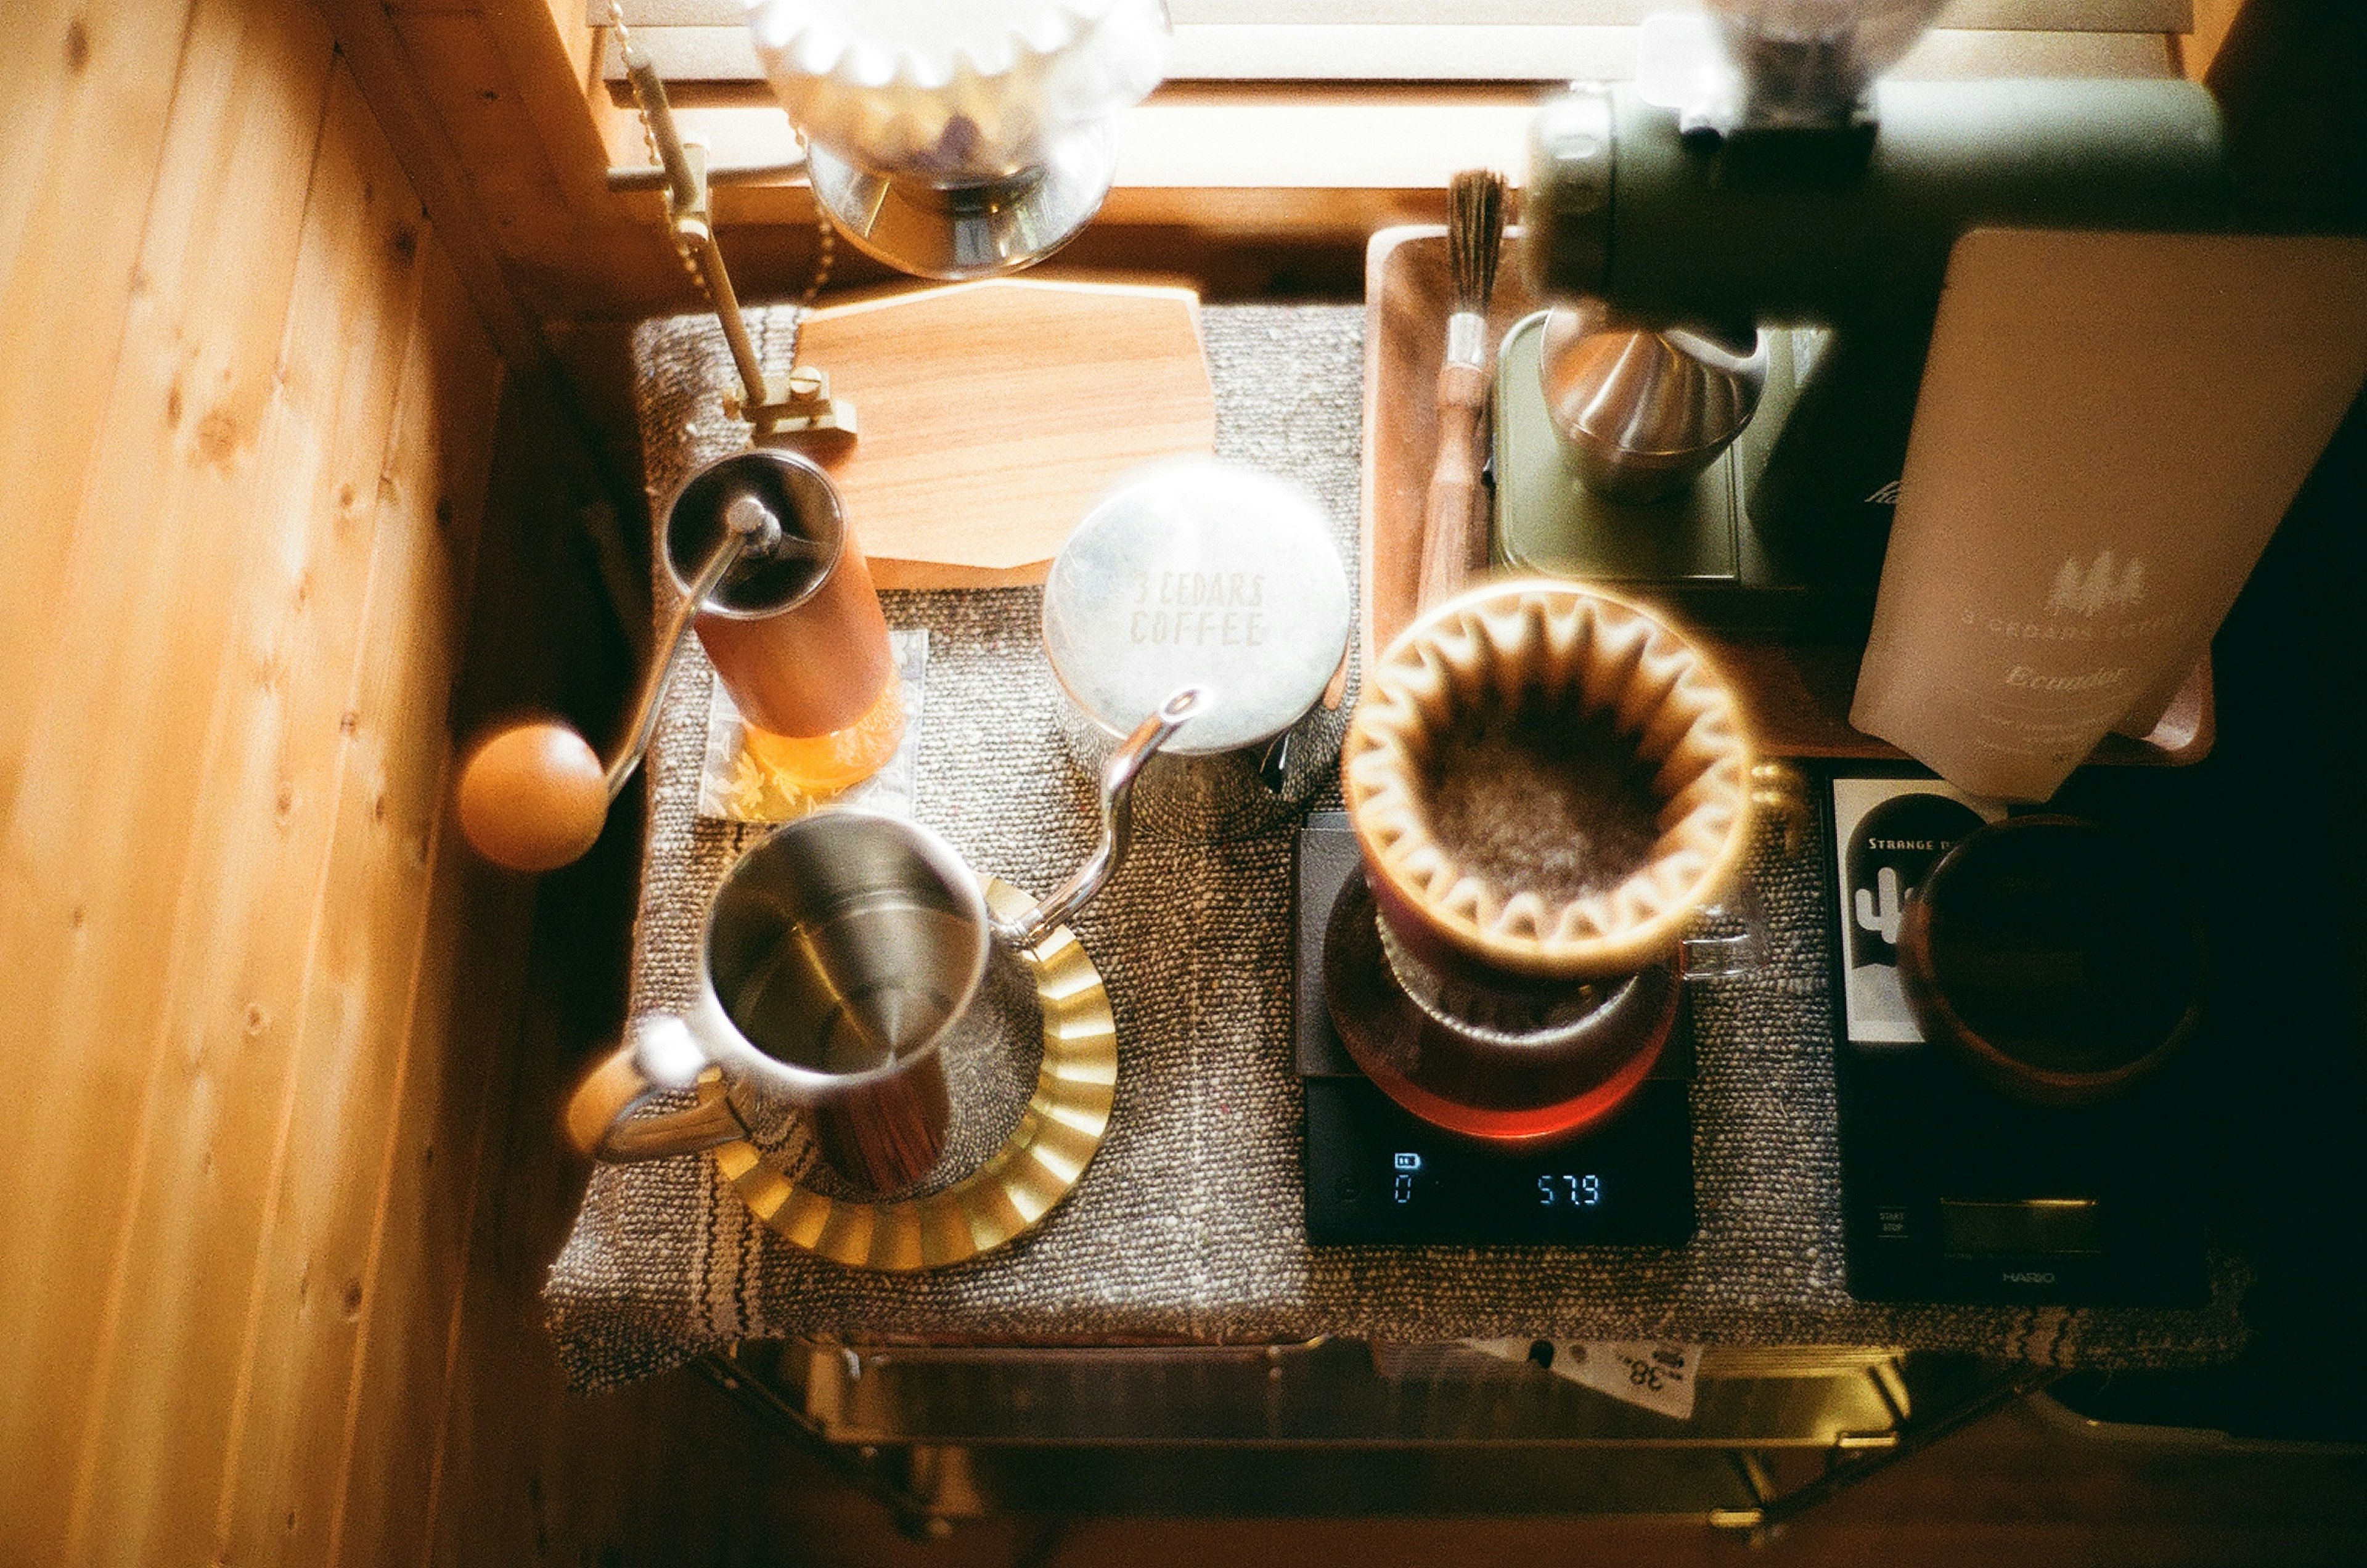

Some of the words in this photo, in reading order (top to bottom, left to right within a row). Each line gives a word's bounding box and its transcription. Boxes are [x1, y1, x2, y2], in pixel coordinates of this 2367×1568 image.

[1133, 570, 1149, 605] 3
[1159, 570, 1267, 607] CEDARS
[1129, 609, 1265, 647] COFFEE
[1868, 838, 1934, 851] STRANGE
[1394, 1174, 1412, 1204] 0
[1538, 1174, 1599, 1205] 57.9
[2002, 1272, 2056, 1283] HARIO
